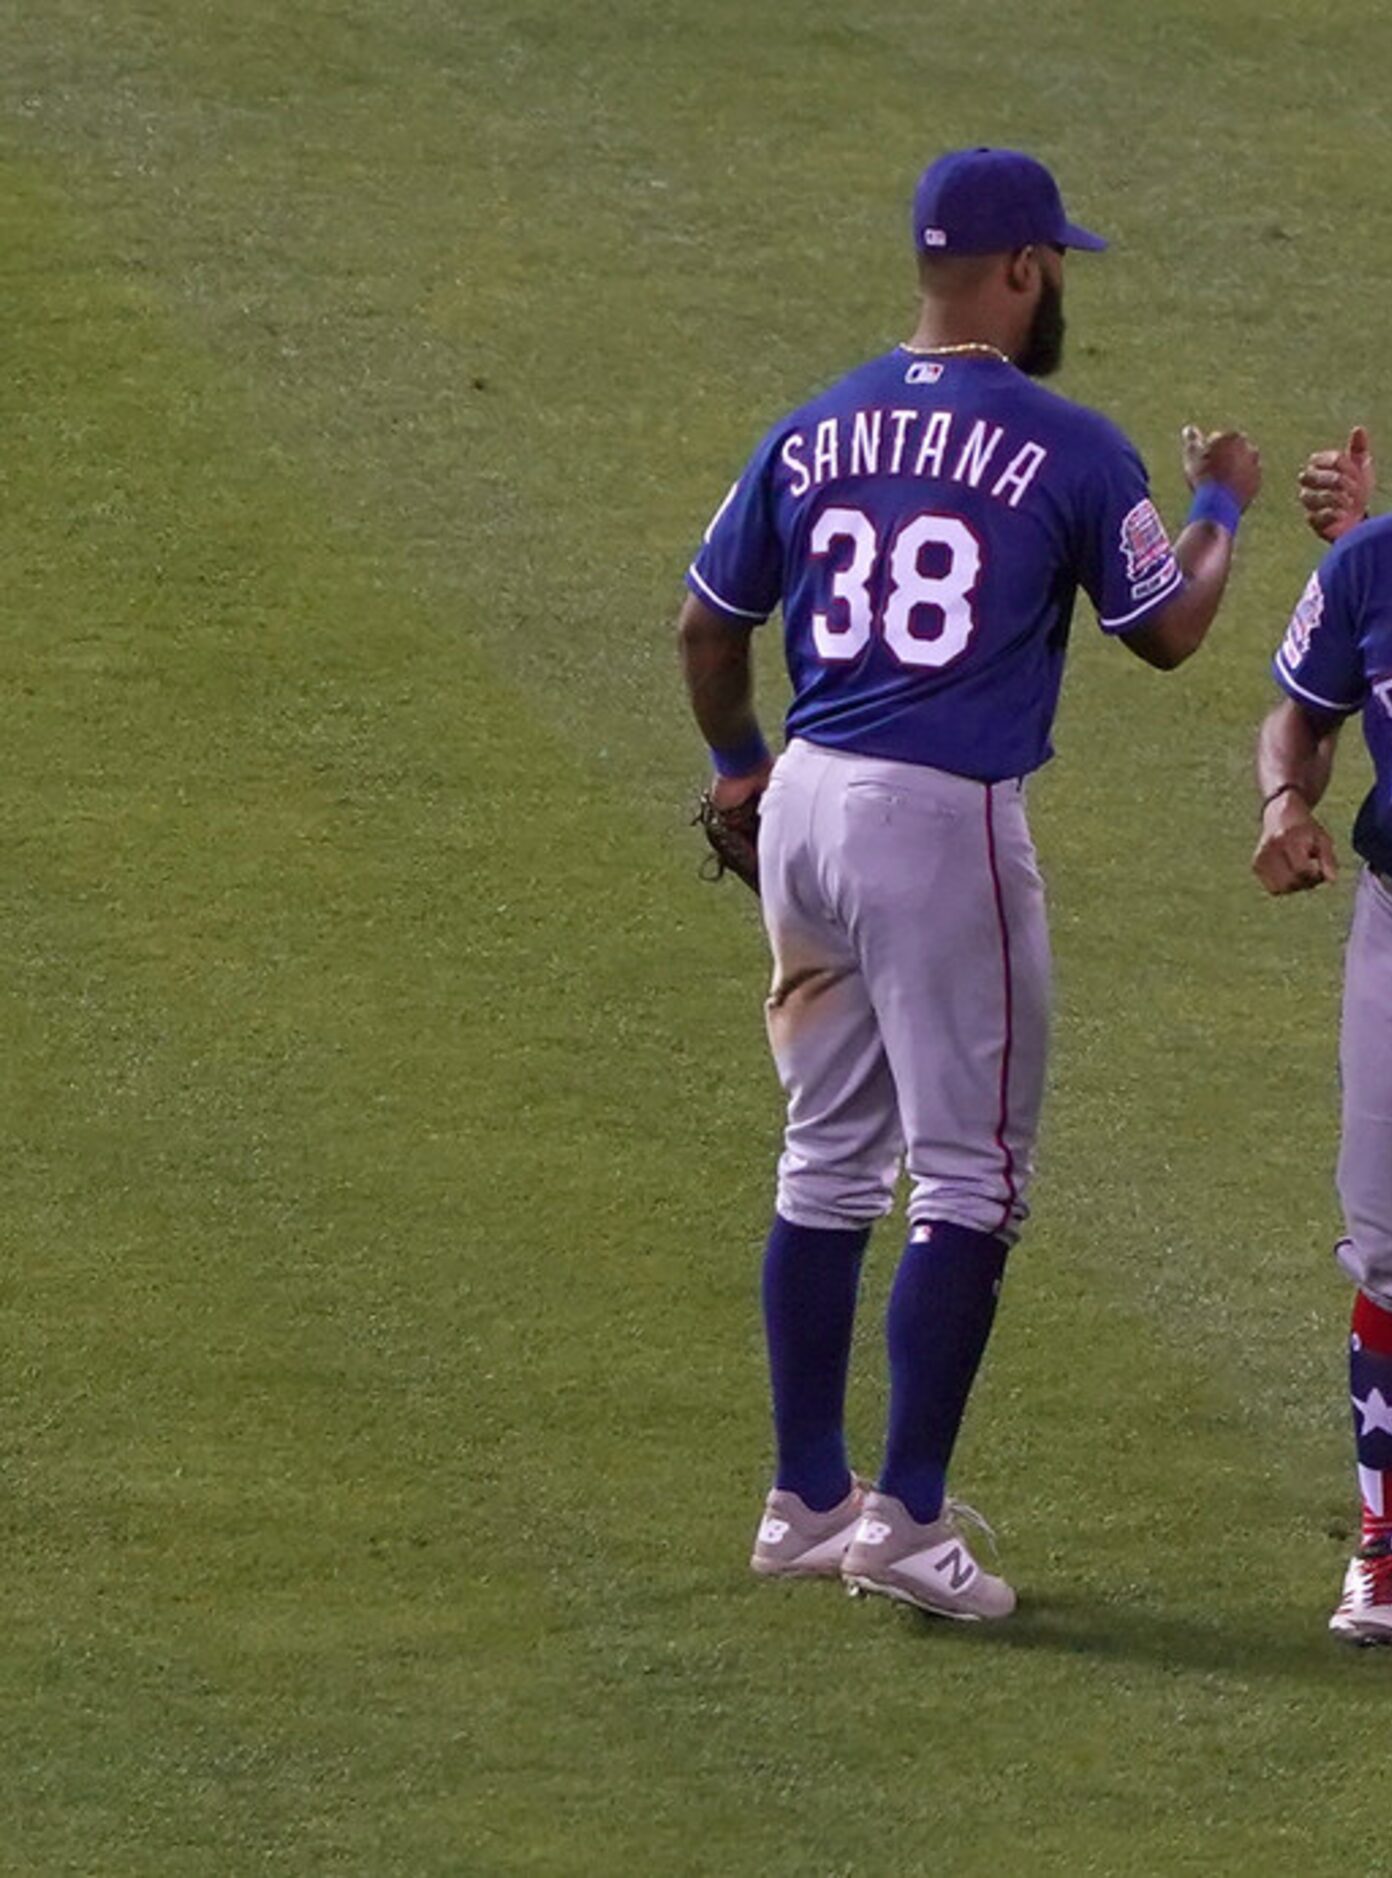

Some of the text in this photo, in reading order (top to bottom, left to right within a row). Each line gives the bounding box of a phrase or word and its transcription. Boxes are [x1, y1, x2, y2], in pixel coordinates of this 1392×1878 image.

[781, 410, 1047, 506] SANTANA
[811, 507, 981, 668] 38
[934, 1547, 975, 1592] N
